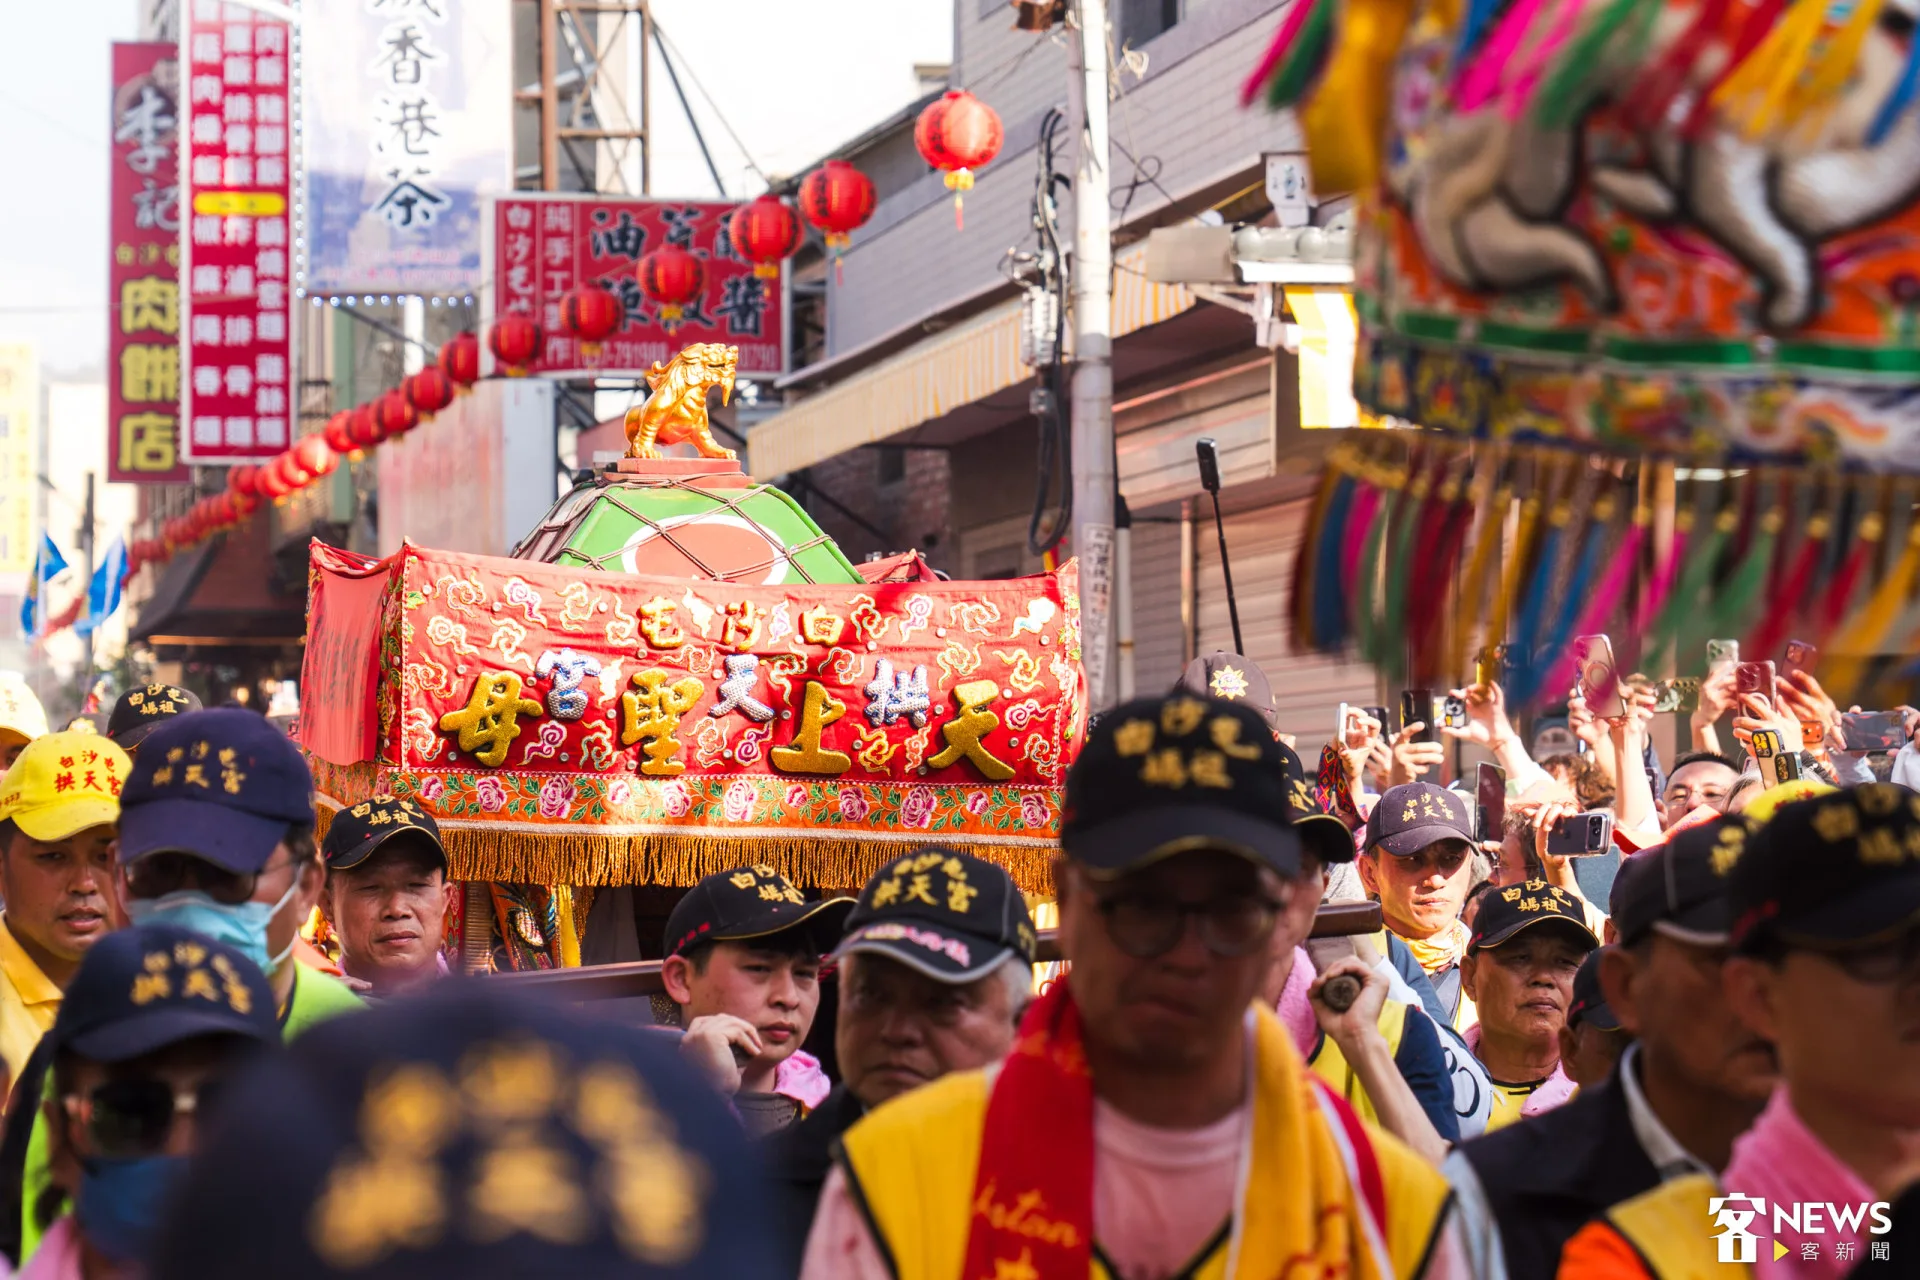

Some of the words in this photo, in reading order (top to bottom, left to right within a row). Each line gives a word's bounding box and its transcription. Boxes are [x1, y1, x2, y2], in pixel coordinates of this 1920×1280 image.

[504, 205, 534, 314] 白沙屯
[128, 683, 190, 707] 白沙屯
[139, 700, 178, 716] 媽祖
[59, 750, 117, 773] 白沙屯
[54, 771, 122, 797] 拱天宮
[350, 794, 425, 819] 白沙屯
[1406, 792, 1447, 808] 白沙屯
[368, 809, 414, 826] 媽祖
[1402, 804, 1454, 822] 拱天宮
[1501, 876, 1572, 907] 白沙屯
[1517, 897, 1561, 914] 媽祖
